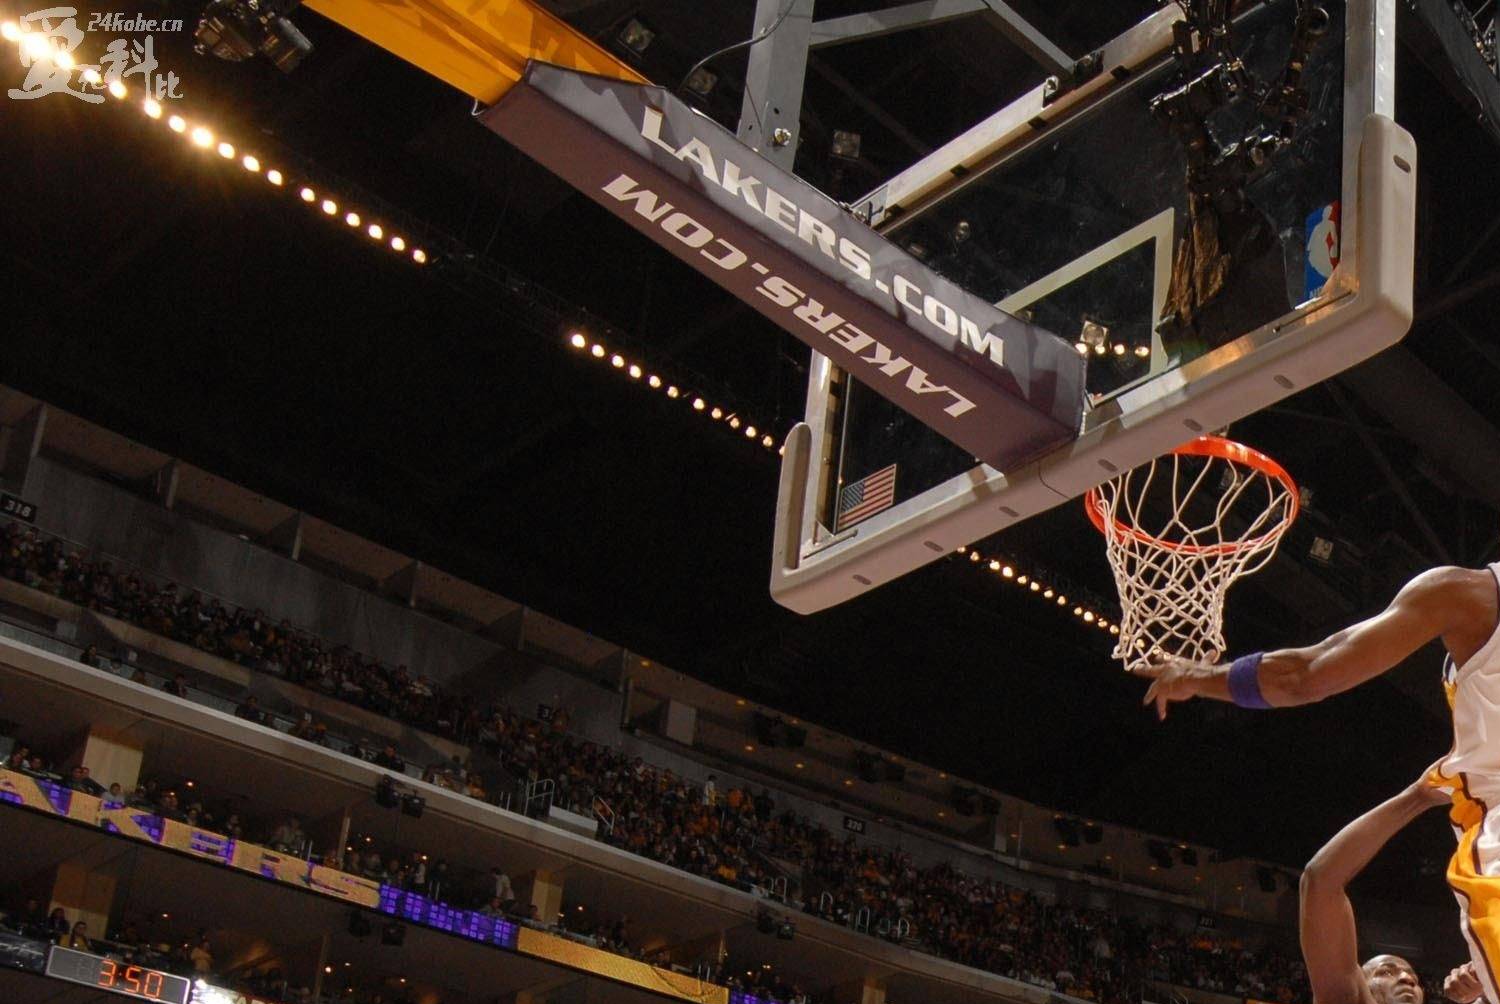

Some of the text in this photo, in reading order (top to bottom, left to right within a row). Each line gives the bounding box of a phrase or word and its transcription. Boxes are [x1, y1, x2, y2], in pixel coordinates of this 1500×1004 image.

[602, 173, 977, 419] LAKERS.COM
[641, 105, 1005, 366] LAKERS.COM
[98, 959, 164, 999] 3:50
